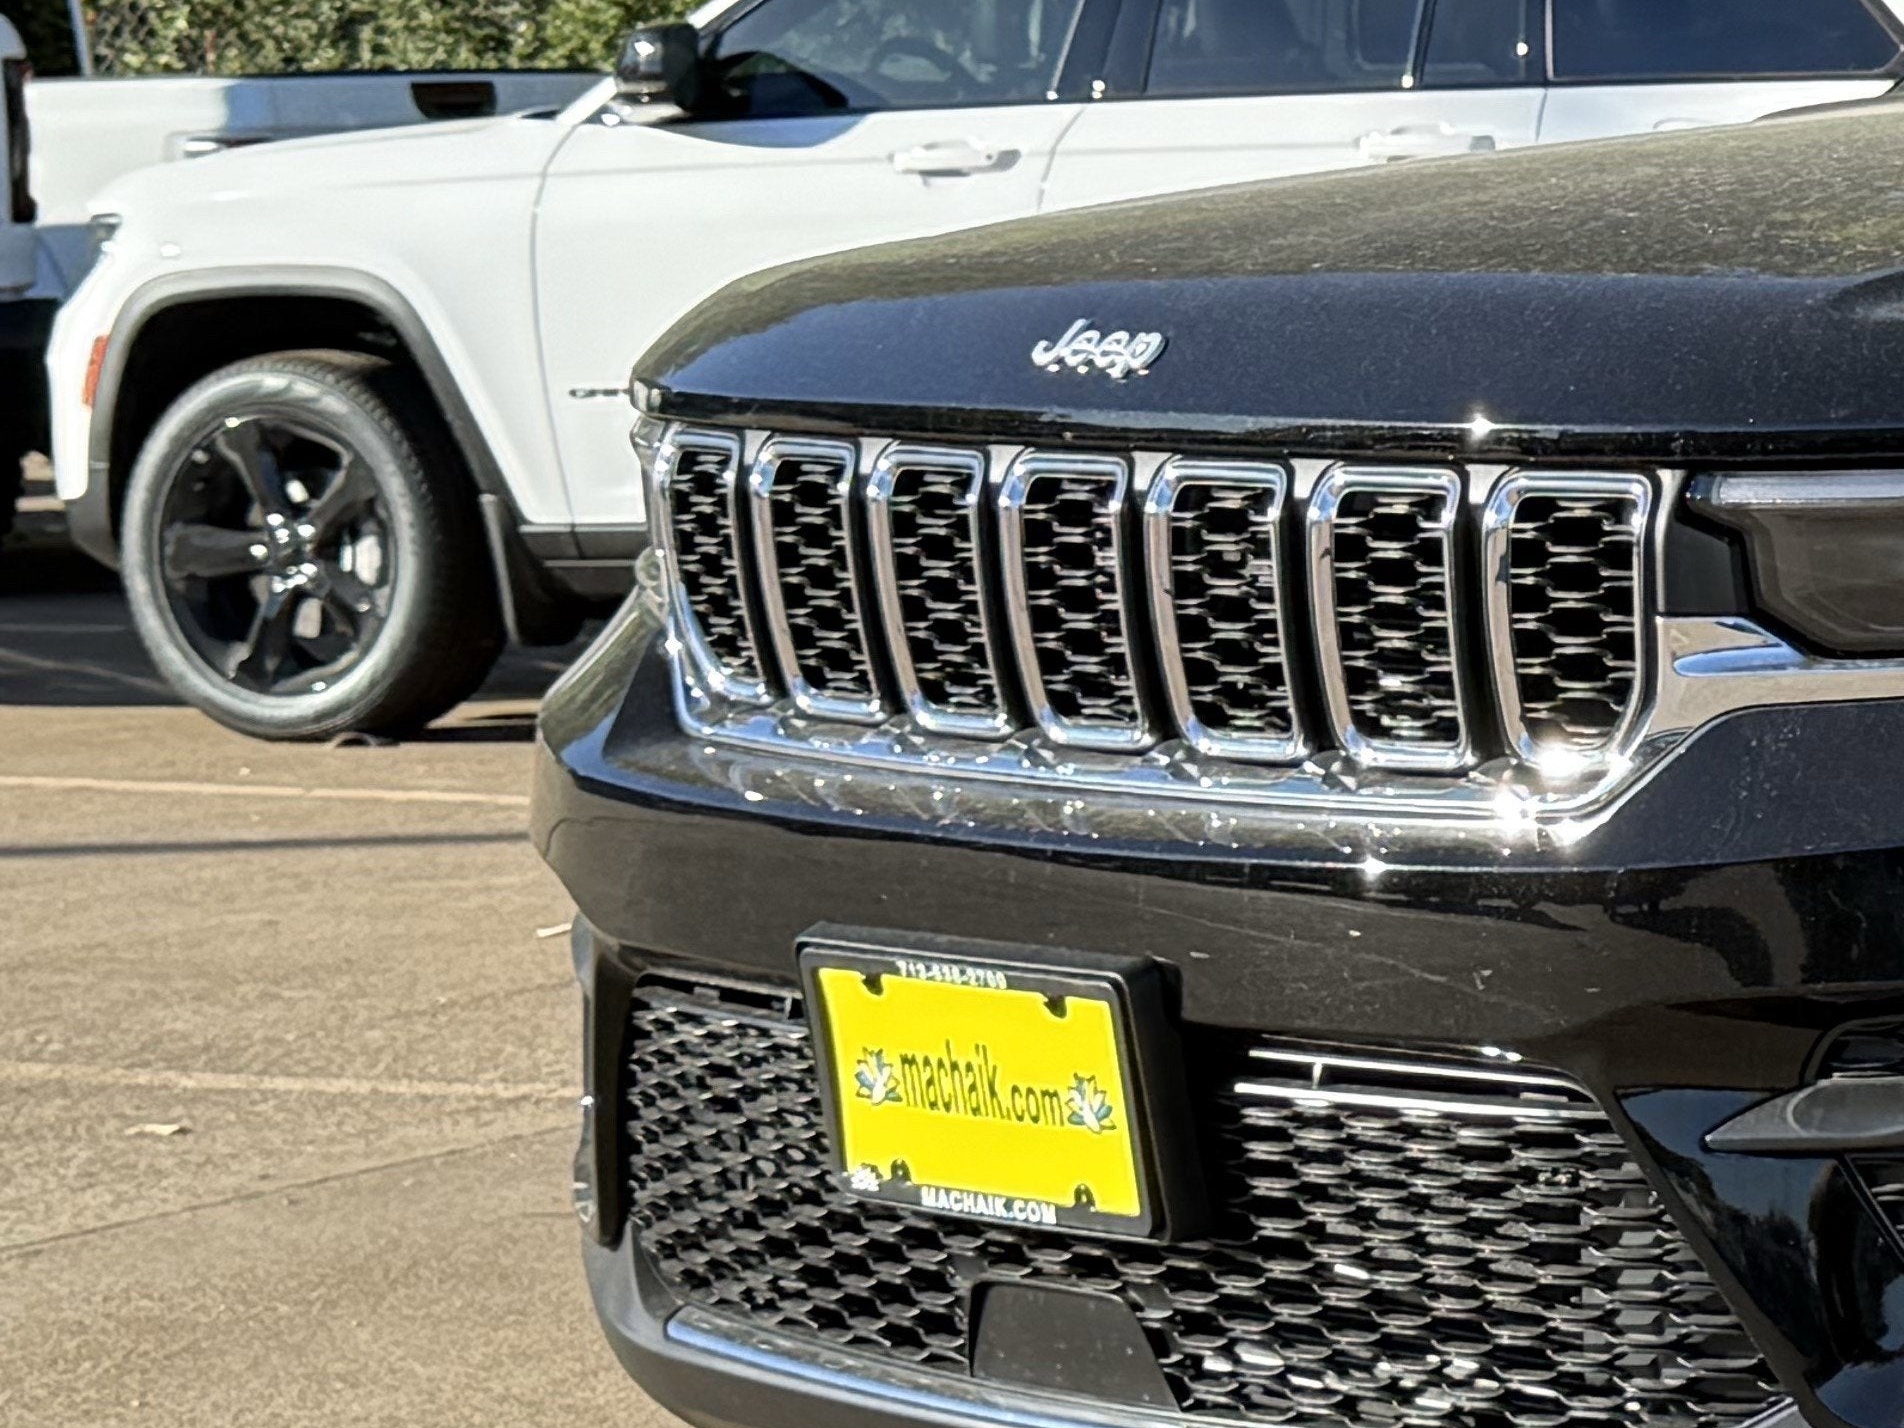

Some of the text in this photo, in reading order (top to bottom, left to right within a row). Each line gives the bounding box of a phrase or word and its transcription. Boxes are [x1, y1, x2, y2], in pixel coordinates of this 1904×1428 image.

[1031, 318, 1167, 380] Jeep
[899, 1038, 1065, 1126] machaik.com
[920, 1185, 1057, 1225] MACHAIK.COM
